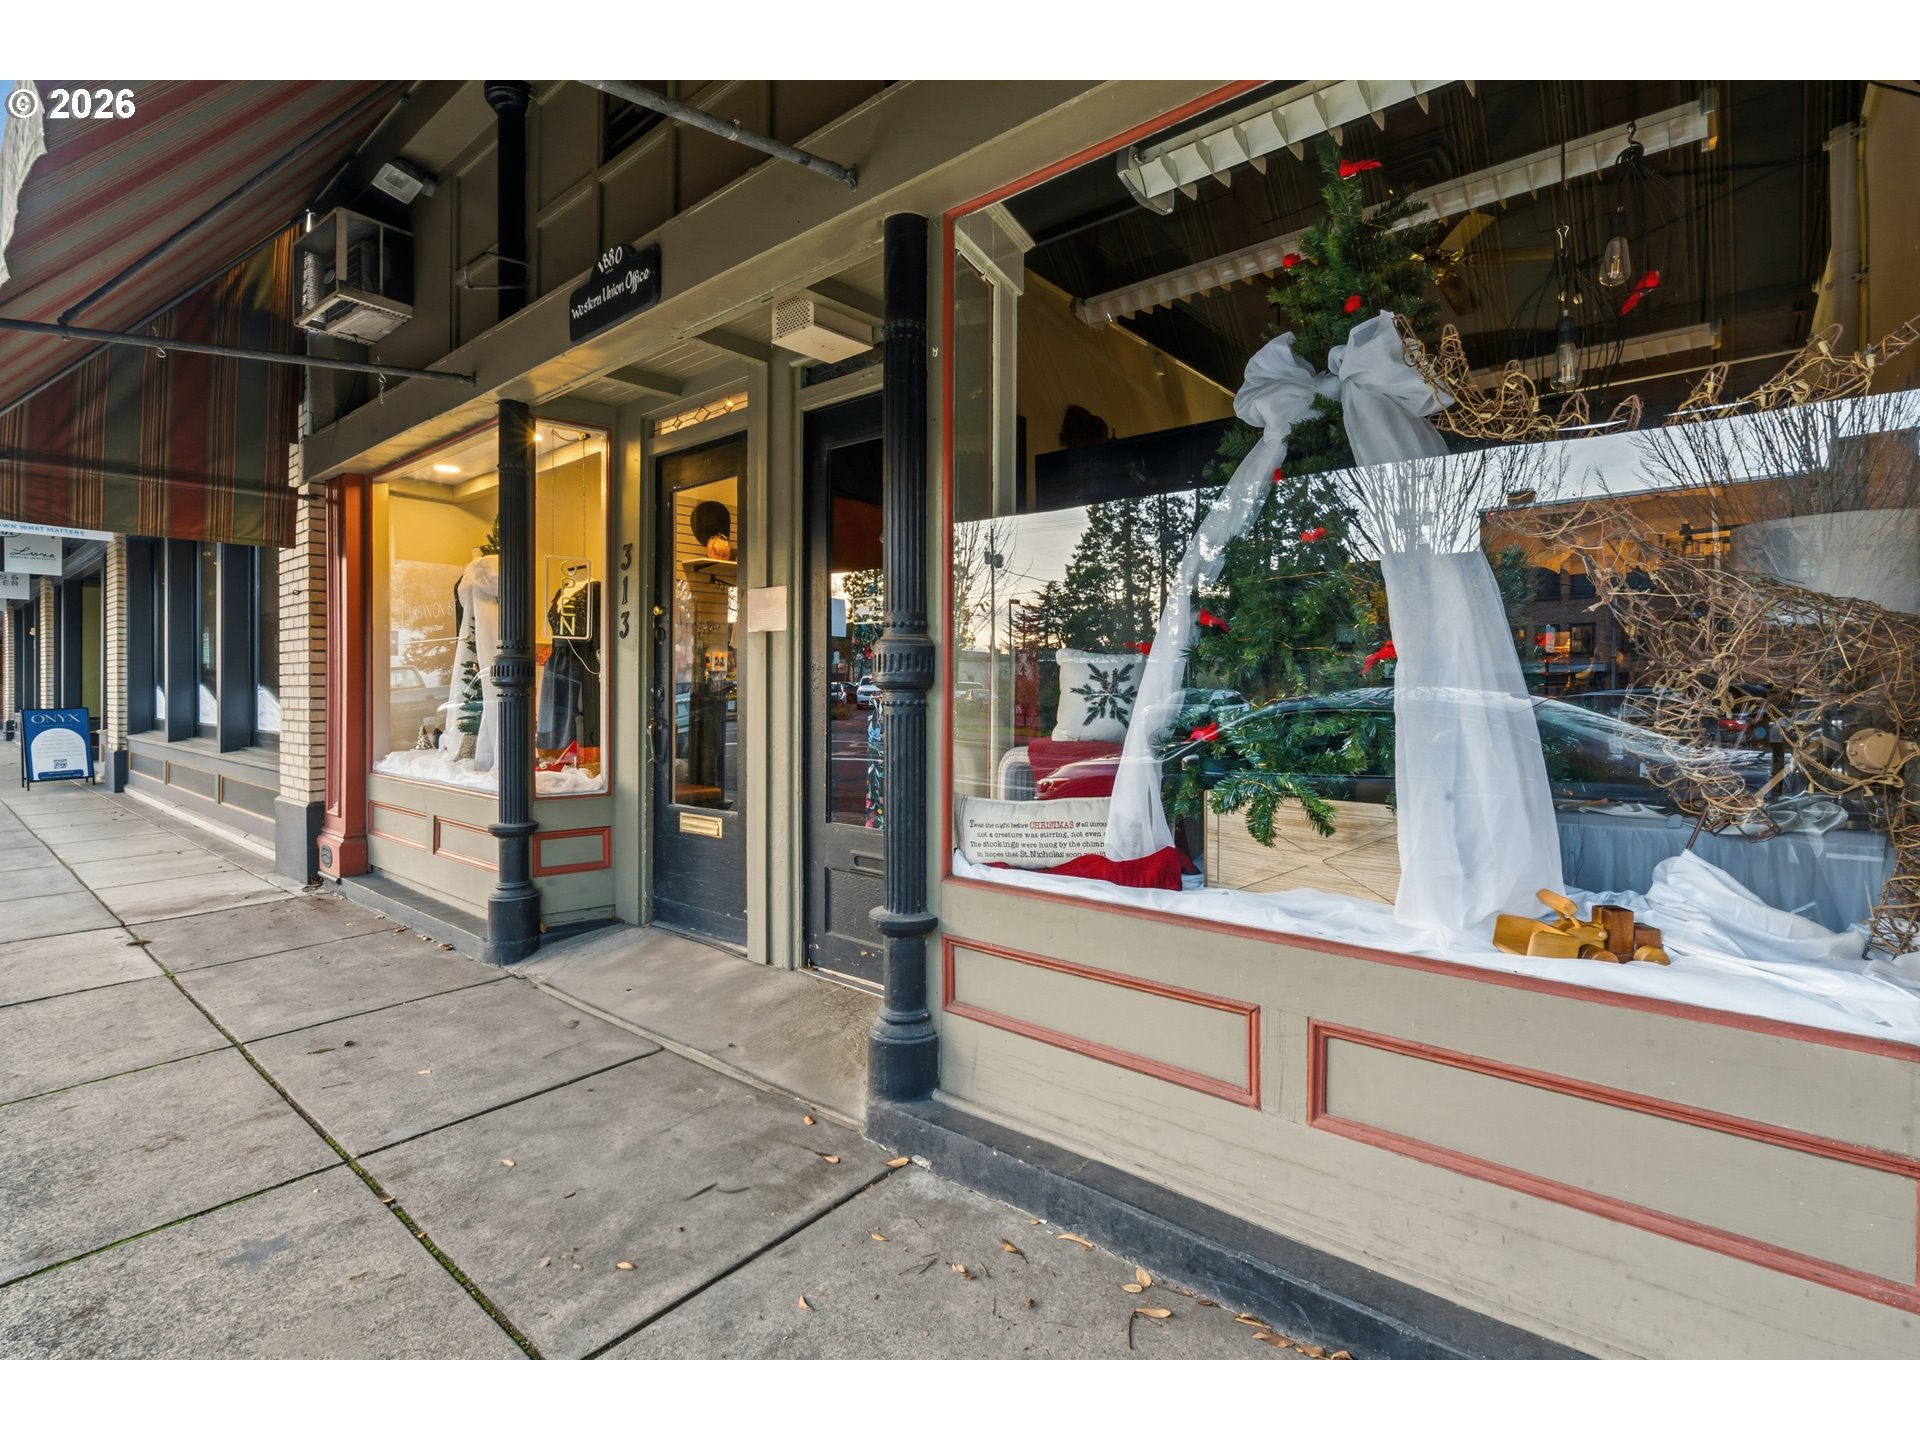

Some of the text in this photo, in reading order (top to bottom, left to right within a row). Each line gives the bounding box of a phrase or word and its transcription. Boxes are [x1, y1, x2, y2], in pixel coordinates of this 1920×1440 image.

[597, 246, 623, 274] 1880
[571, 268, 650, 320] Western Union Office
[20, 524, 45, 533] WHAT
[46, 527, 85, 536] MATTERS
[619, 542, 633, 640] 313
[561, 560, 576, 636] OPEN
[31, 713, 81, 723] ONYX
[995, 822, 1010, 830] night
[1029, 821, 1074, 830] CHRISTMAS
[970, 840, 982, 848] The
[982, 840, 1020, 849] stockings
[1038, 841, 1058, 849] hung
[1058, 841, 1068, 849] by
[1068, 840, 1081, 848] the
[984, 850, 1004, 859] hopes
